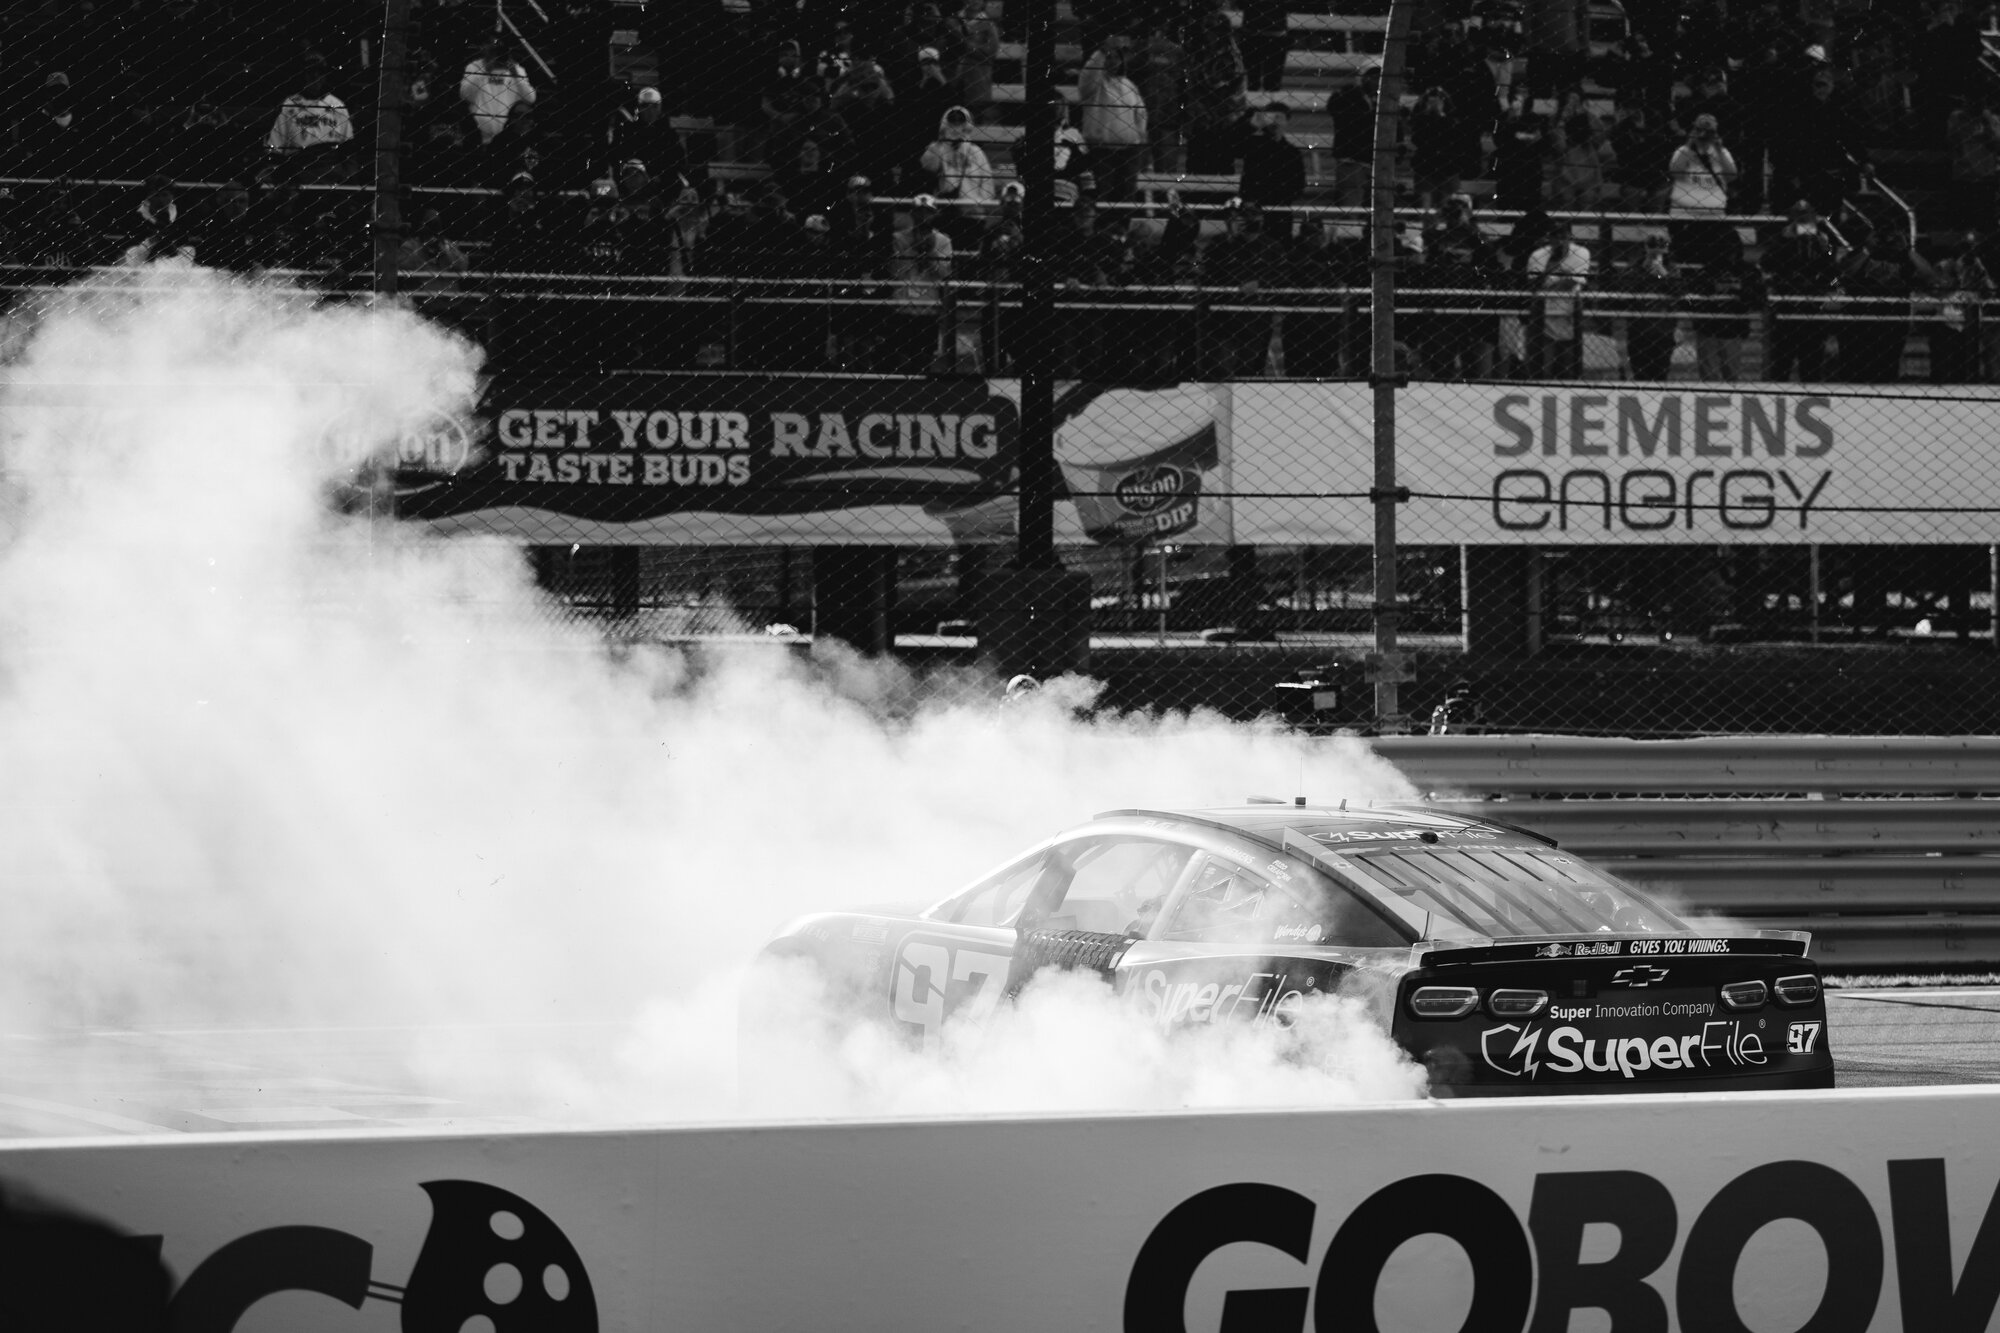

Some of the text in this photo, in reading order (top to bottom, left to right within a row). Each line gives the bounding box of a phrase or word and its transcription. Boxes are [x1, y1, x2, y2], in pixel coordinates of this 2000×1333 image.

[498, 408, 751, 449] GET YOUR
[769, 411, 999, 459] RACING
[1492, 394, 1834, 458] SIEMENS
[498, 454, 751, 486] TASTE BUDS
[1155, 502, 1194, 531] DIP
[1630, 940, 1661, 954] GIVES
[893, 941, 1012, 1060] 97
[1550, 1001, 1715, 1021] Super Innovation Company
[1787, 1021, 1820, 1054] 97
